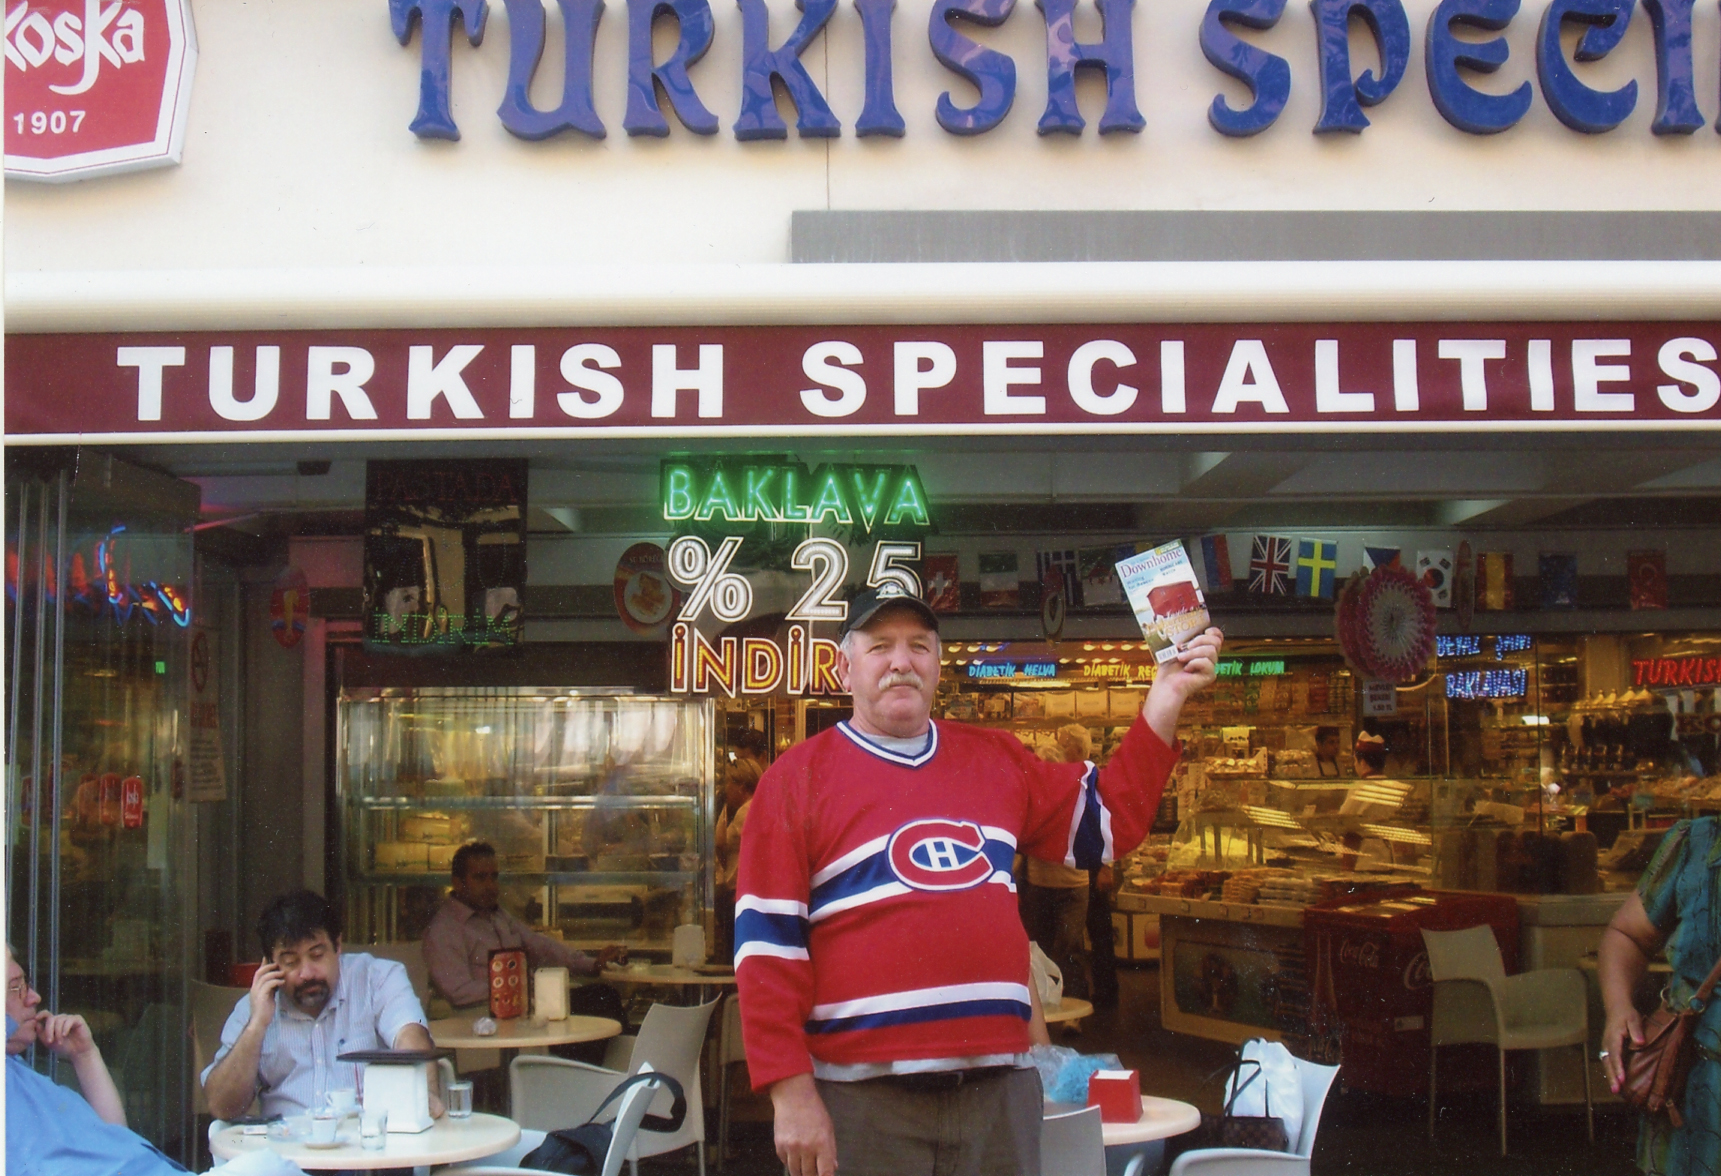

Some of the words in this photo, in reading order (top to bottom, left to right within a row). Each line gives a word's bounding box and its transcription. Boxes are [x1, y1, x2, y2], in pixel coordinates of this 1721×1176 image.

[391, 0, 1146, 141] TURKISH
[1199, 0, 1721, 138] SPECI
[13, 110, 86, 135] 1907
[116, 343, 725, 422] TURKISH
[800, 336, 1721, 419] SPECIALITIES
[664, 462, 931, 534] BAKLAVA
[668, 536, 753, 622] %
[1120, 549, 1182, 578] Downhome
[670, 622, 852, 698] İNDİR
[1249, 661, 1285, 676] LOKUM
[1446, 669, 1526, 699] BAKLAVASI
